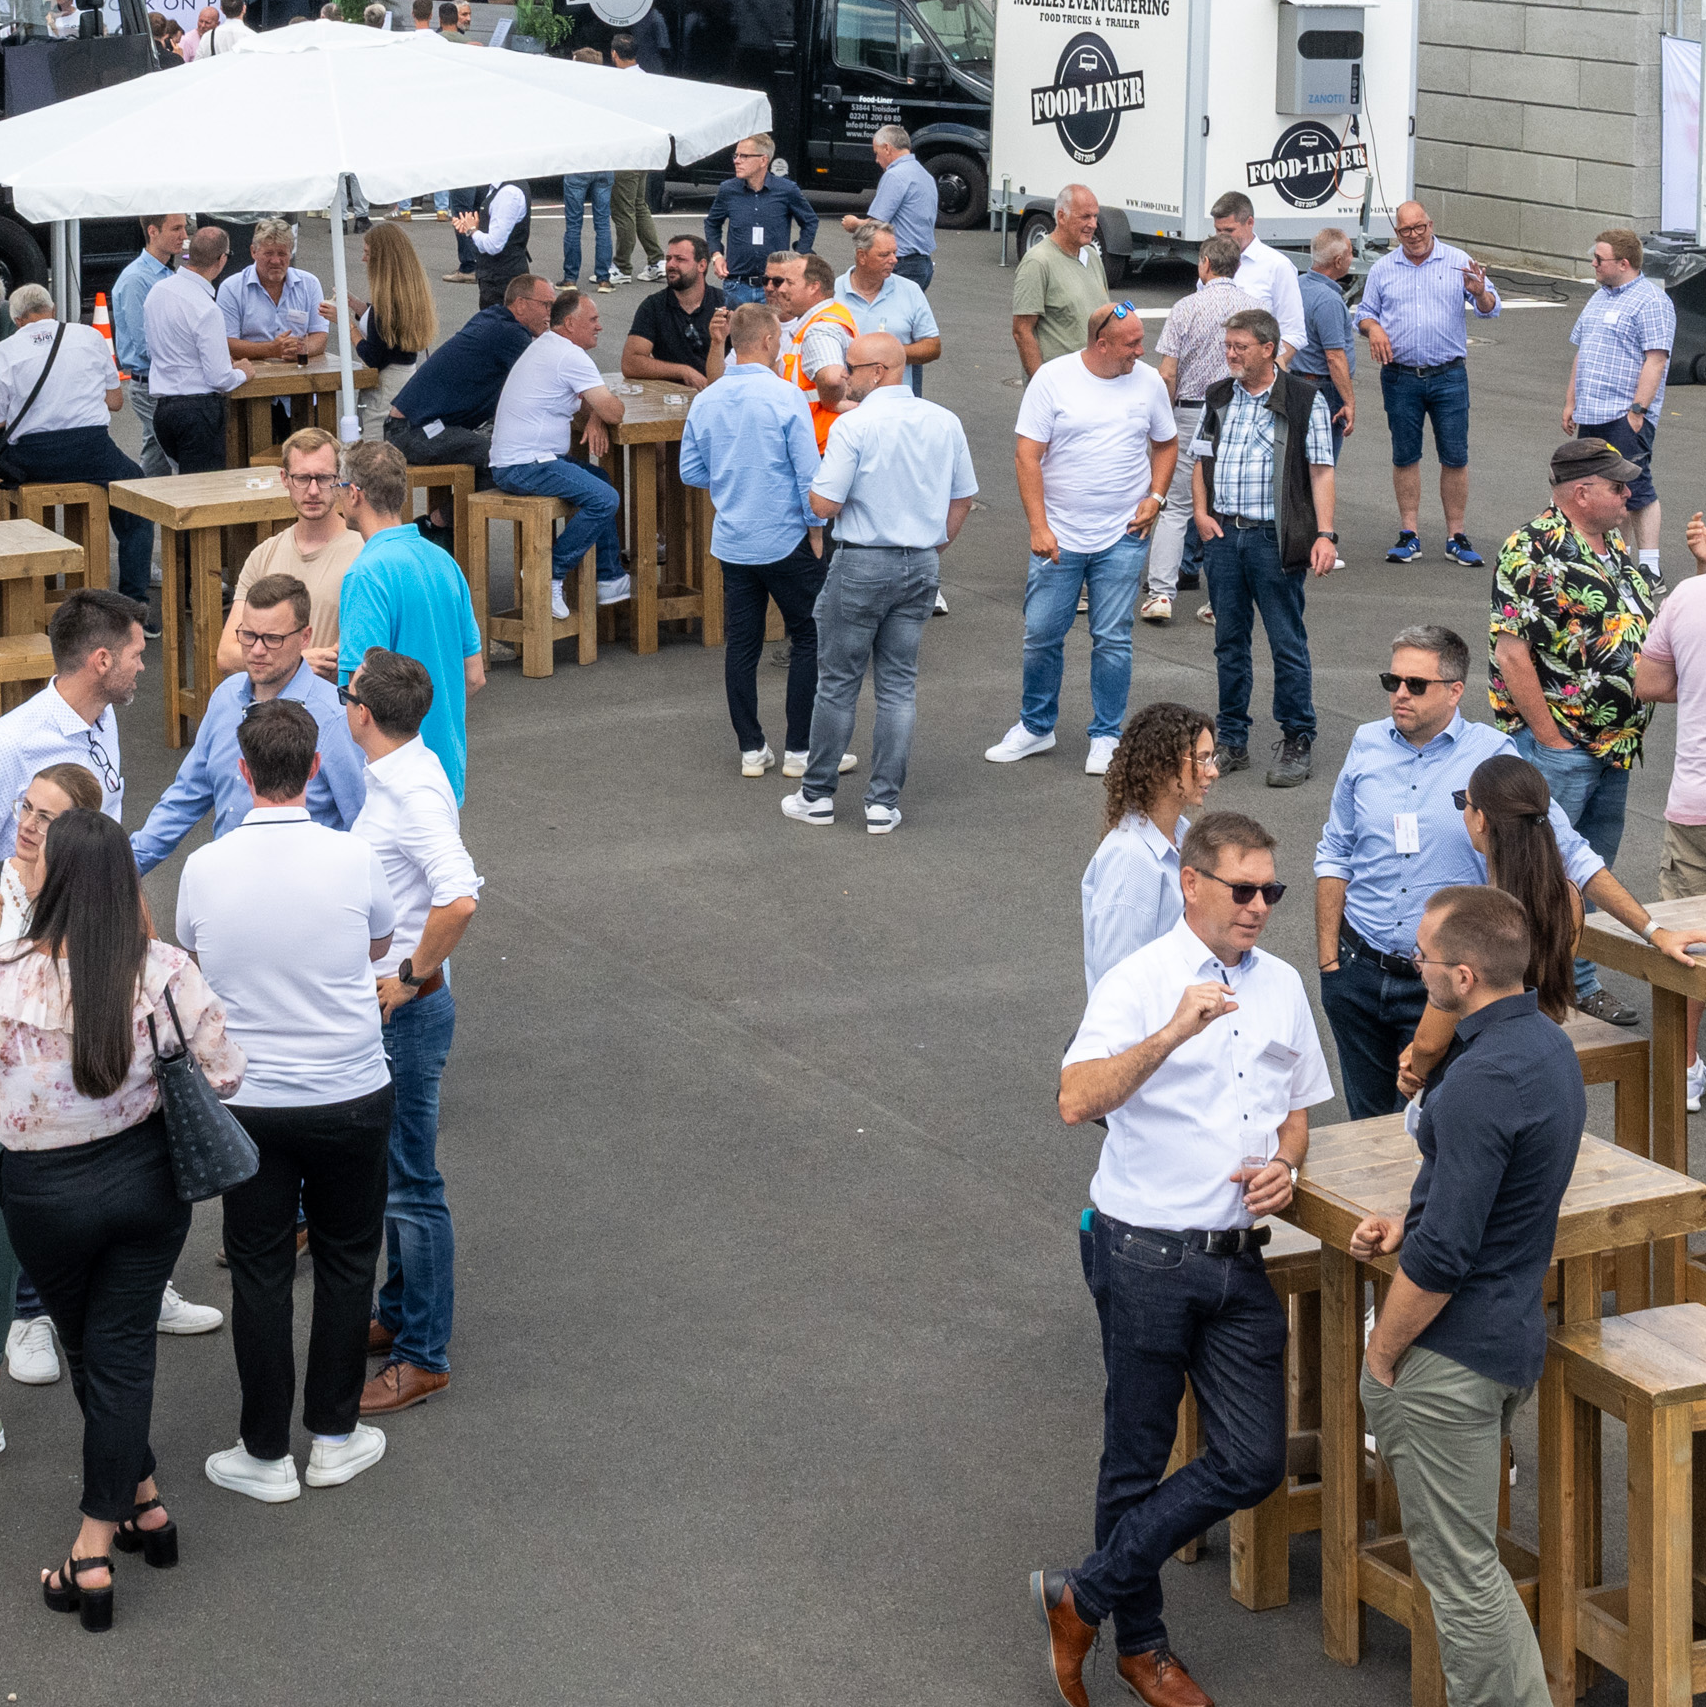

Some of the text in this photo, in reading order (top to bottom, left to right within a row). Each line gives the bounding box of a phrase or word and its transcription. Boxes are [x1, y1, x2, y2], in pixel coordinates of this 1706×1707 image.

[1039, 12, 1140, 29] FOOD TRUCKS & TRAILER
[858, 95, 893, 104] Food-Liner
[1032, 76, 1144, 120] FOOD-LINER
[1308, 94, 1345, 104] ZANOTTI
[1248, 147, 1367, 185] FOOD-LINER
[1125, 198, 1180, 213] WWW.FOOD-LINER.DE
